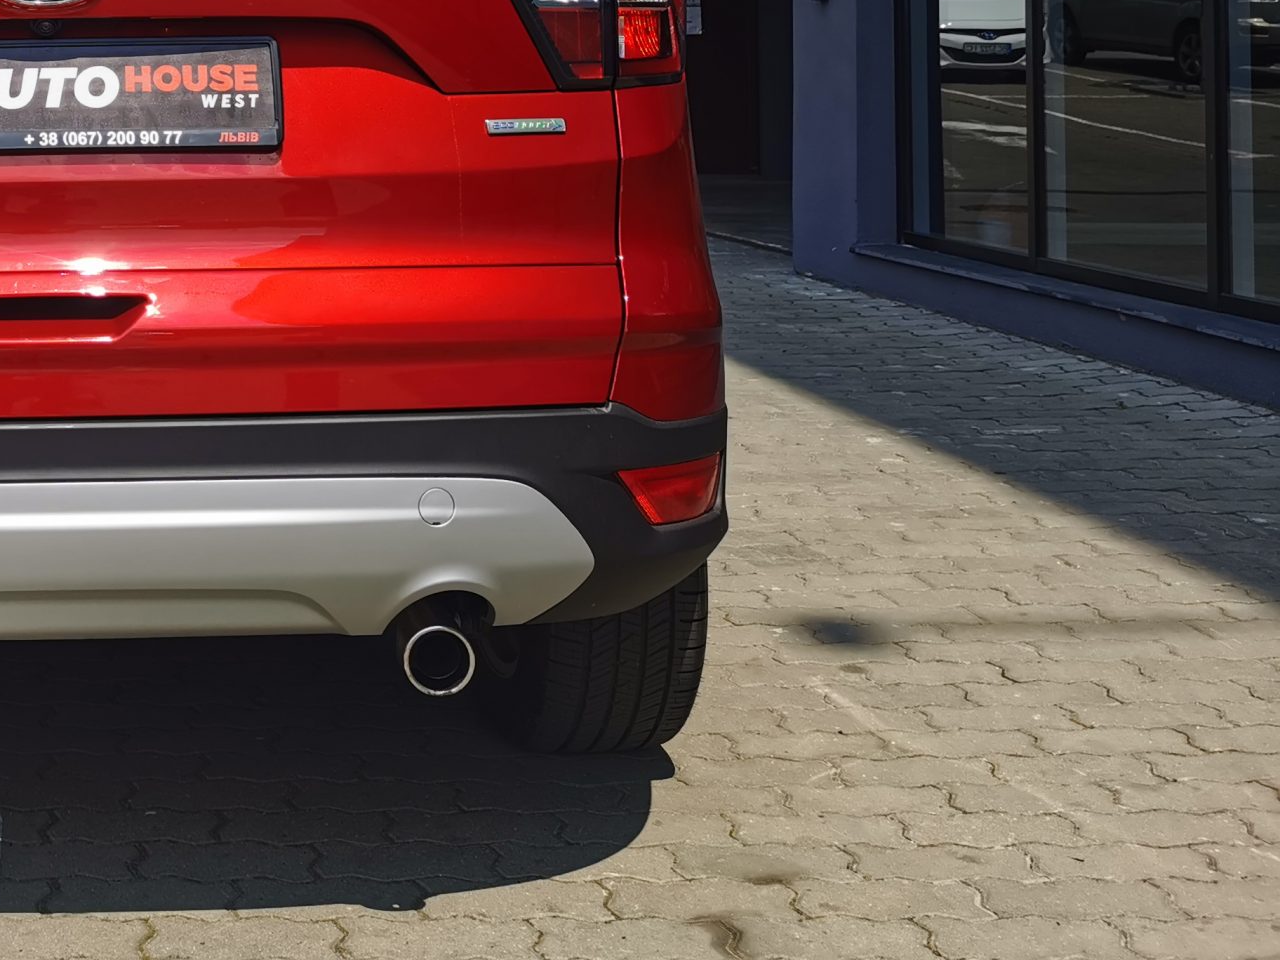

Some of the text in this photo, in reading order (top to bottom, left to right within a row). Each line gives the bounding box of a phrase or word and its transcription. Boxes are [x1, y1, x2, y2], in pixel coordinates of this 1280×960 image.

[201, 93, 259, 109] WEST
[39, 132, 58, 146] 38
[63, 131, 102, 146] (067)
[106, 130, 135, 145] 200
[139, 130, 159, 145] 90
[163, 130, 183, 144] 77
[219, 131, 260, 143] ЛЬВІВ
